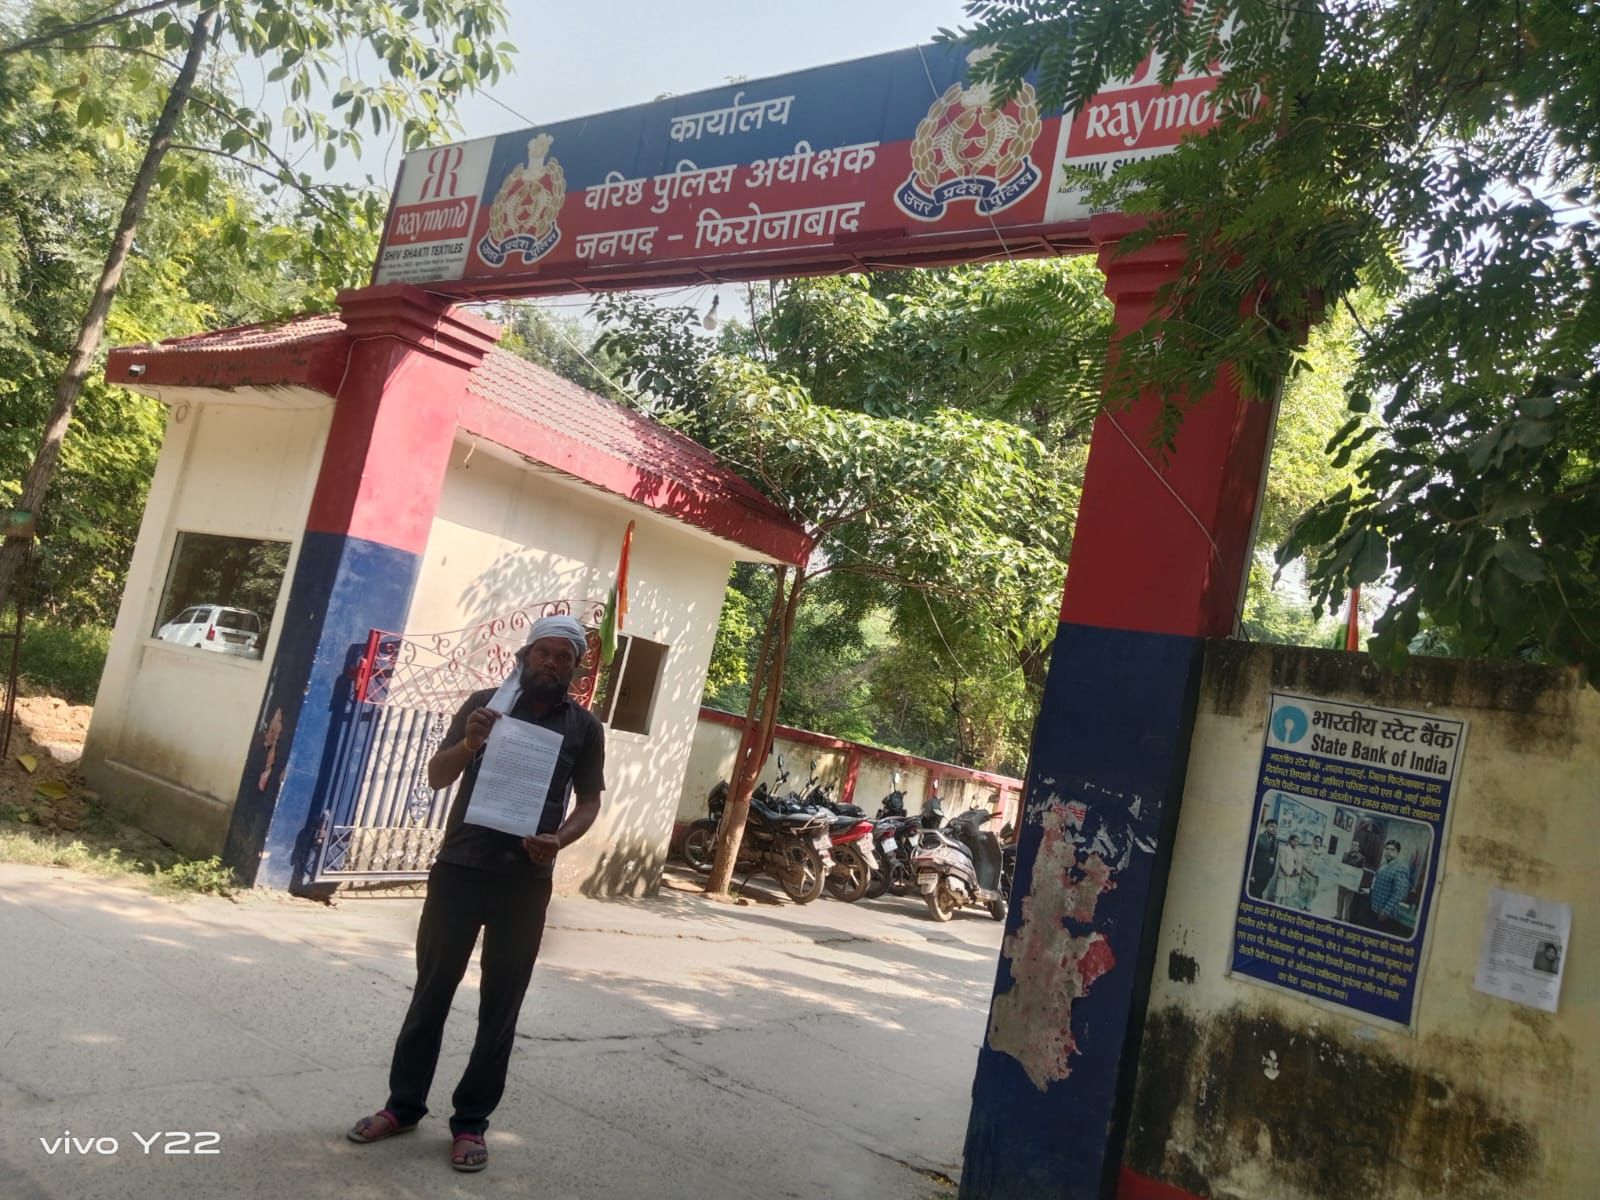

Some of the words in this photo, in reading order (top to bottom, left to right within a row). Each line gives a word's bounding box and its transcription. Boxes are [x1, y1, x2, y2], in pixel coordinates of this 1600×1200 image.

[670, 92, 795, 142] कार्यालय
[584, 171, 647, 210] वरिष्ठ
[650, 159, 738, 213] पुलिस
[745, 140, 880, 188] अधीक्षक
[903, 190, 935, 215] उत्तर
[942, 180, 985, 200] प्रदेश
[990, 171, 1033, 210] पुलिस
[397, 202, 467, 240] Raymond
[575, 226, 659, 259] जनपद
[695, 202, 866, 249] फिरोजाबाद
[384, 250, 402, 261] SHIV
[402, 246, 430, 259] SHAKTI
[431, 242, 464, 256] TEXTILES
[1313, 711, 1374, 736] भारतीय
[1382, 719, 1416, 743] स्टेट
[1421, 723, 1457, 748] बैंक
[1312, 735, 1346, 757] State
[1352, 742, 1387, 766] Bank
[1390, 749, 1407, 768] of
[1411, 755, 1447, 774] India
